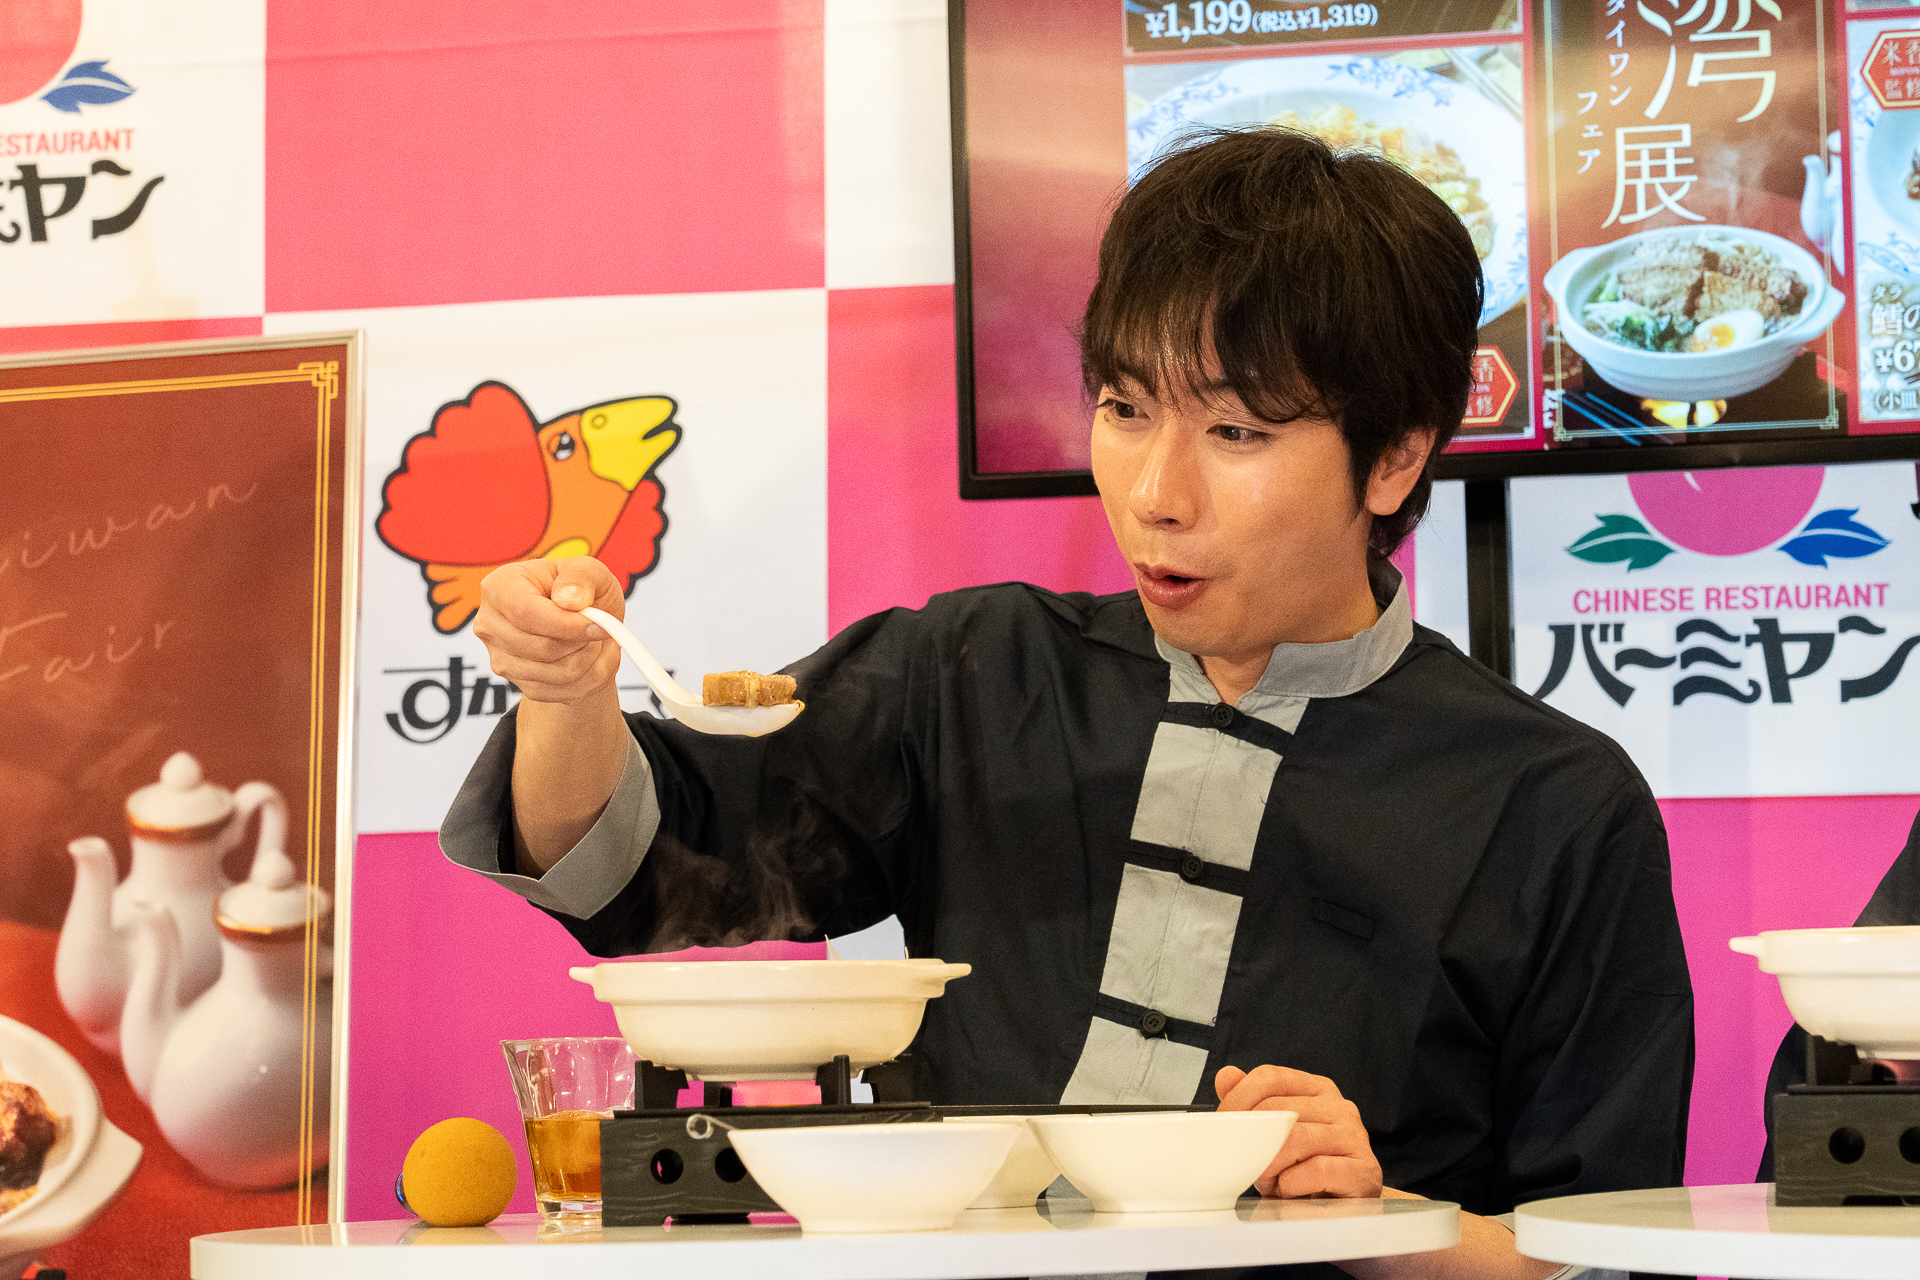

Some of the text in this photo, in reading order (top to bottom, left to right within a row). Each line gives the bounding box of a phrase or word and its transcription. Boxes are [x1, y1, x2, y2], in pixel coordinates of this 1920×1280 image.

[1577, 91, 1604, 174] フェア
[0, 482, 259, 575] iwan
[1573, 583, 1890, 614] CHINESE RESTAURANT
[1533, 615, 1920, 708] バーミヤン
